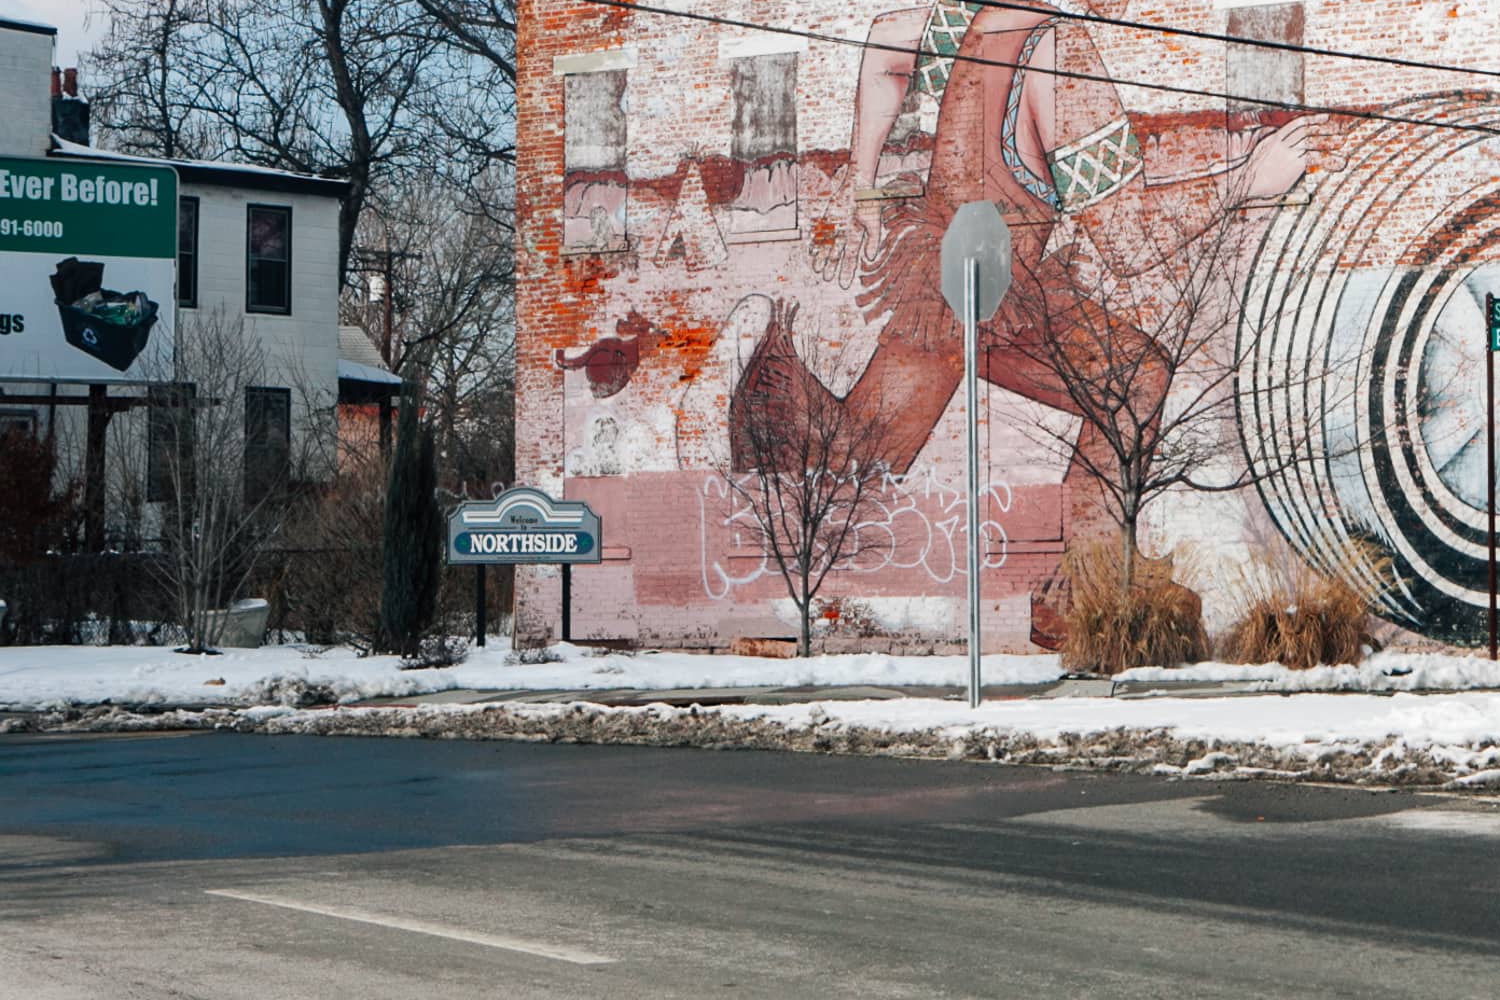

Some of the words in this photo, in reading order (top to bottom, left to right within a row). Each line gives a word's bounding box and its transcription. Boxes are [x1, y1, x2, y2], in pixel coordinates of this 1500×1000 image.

[0, 169, 55, 200] Ever
[60, 173, 158, 206] Before!
[1, 218, 63, 238] 91-6000
[511, 515, 538, 524] Welcome
[470, 533, 578, 553] NORTHSIDE
